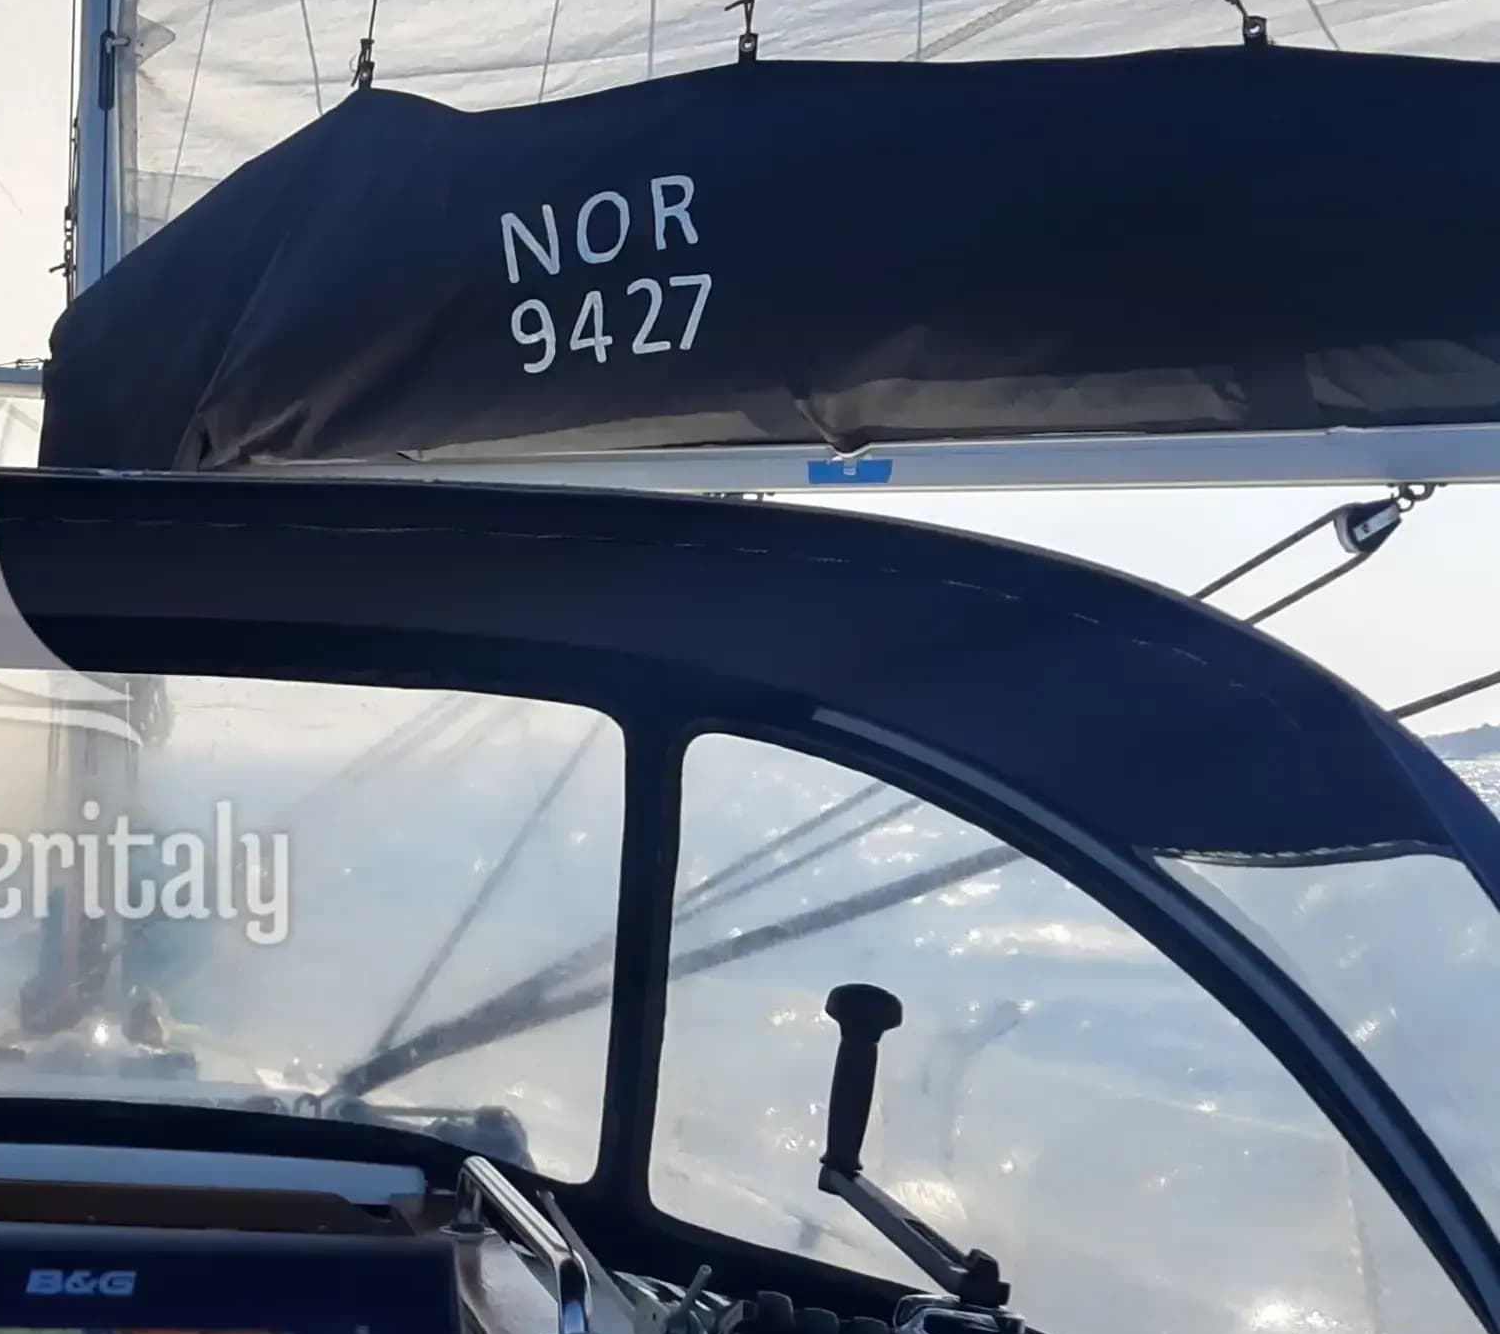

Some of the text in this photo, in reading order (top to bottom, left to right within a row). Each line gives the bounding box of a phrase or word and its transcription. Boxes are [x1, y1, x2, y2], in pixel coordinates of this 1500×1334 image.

[500, 174, 699, 284] NOR
[510, 273, 713, 374] 9427
[25, 1268, 137, 1296] B&G
